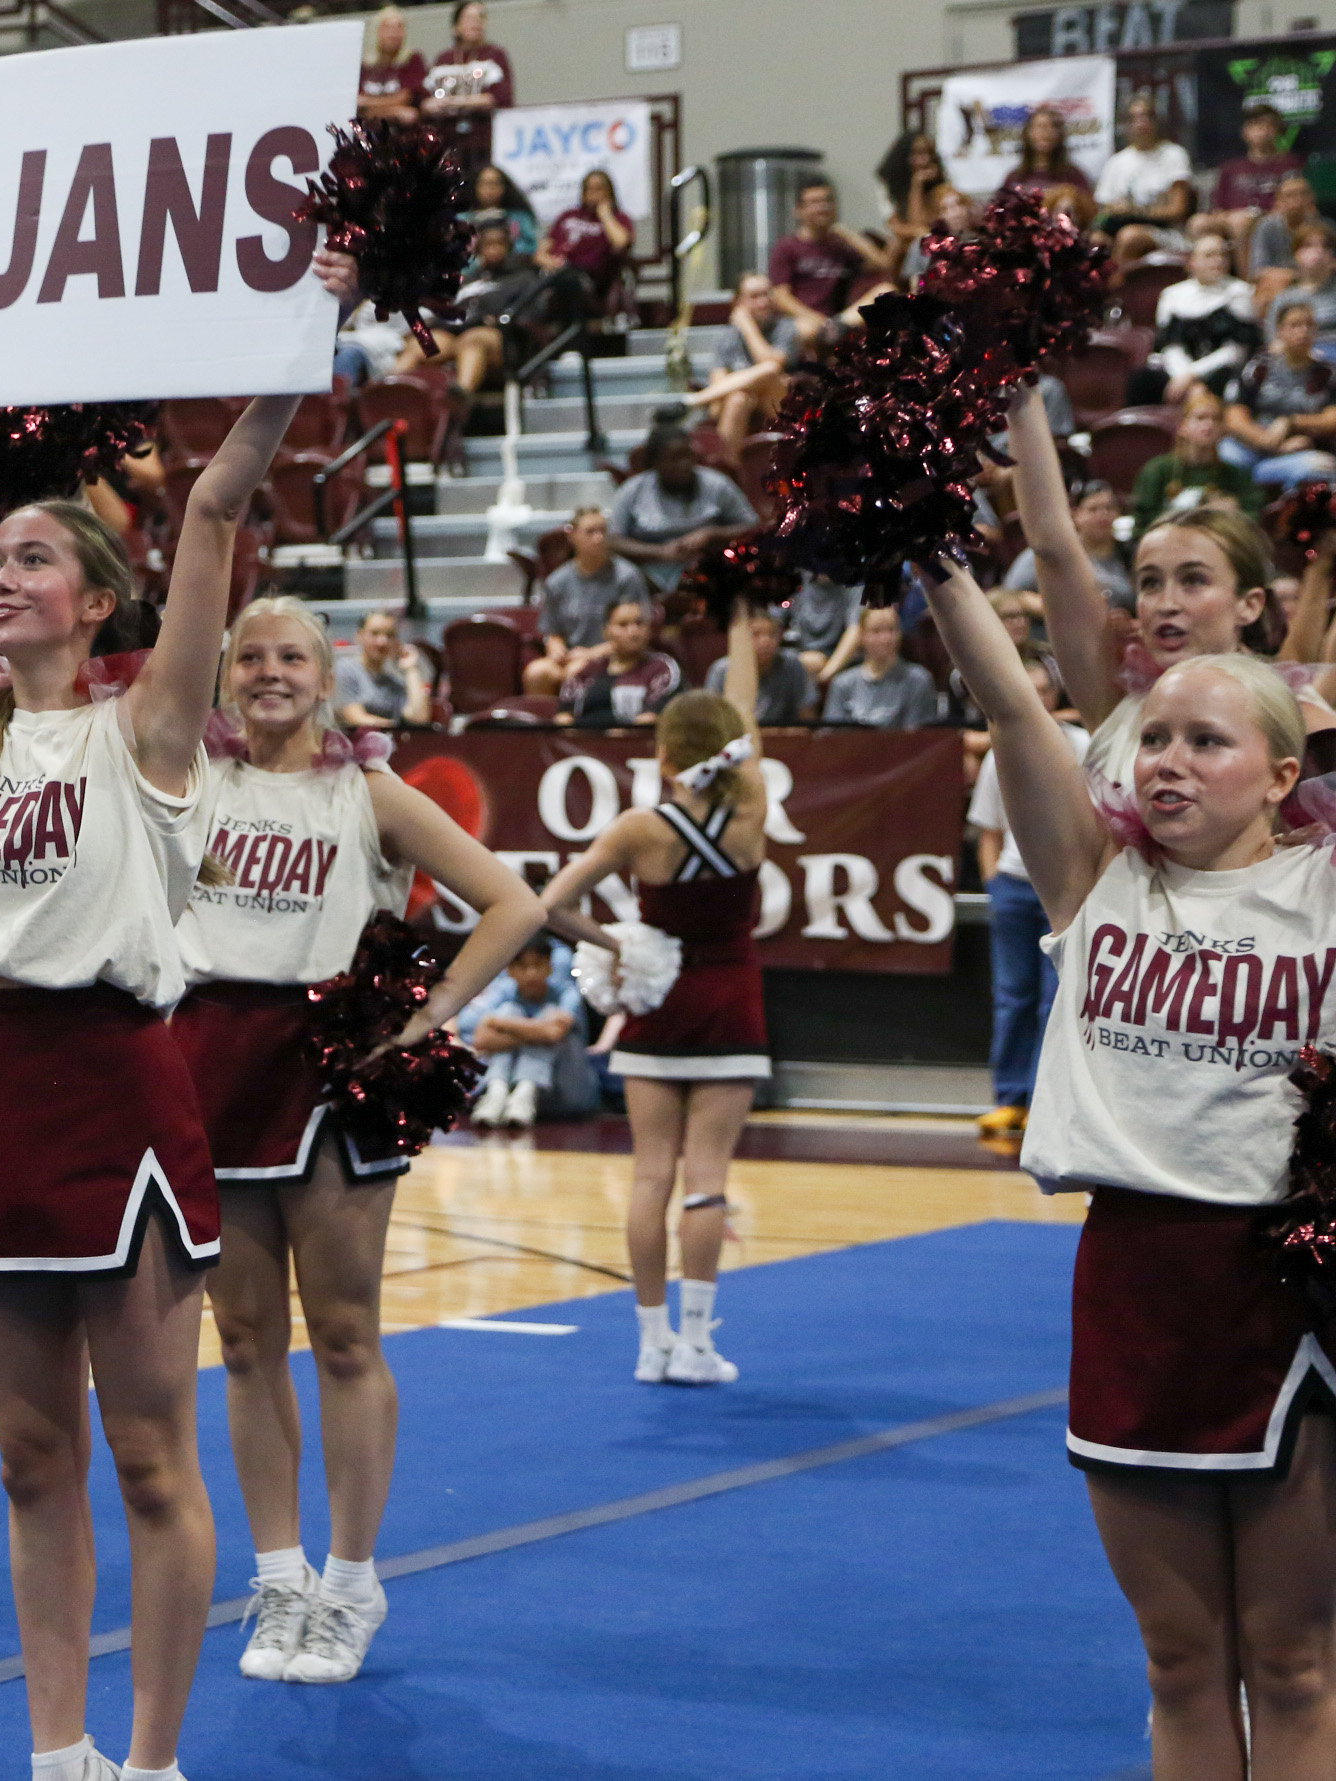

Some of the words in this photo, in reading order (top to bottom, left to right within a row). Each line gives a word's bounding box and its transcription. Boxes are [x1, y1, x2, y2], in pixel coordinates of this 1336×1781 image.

[504, 119, 638, 160] JAYCO
[218, 815, 293, 835] JENKS
[235, 894, 309, 913] UNION
[1155, 930, 1256, 953] JENKS
[1080, 923, 1336, 1051] GAMEDAY
[1098, 1027, 1170, 1057] BEAT
[1181, 1043, 1303, 1068] UNION
